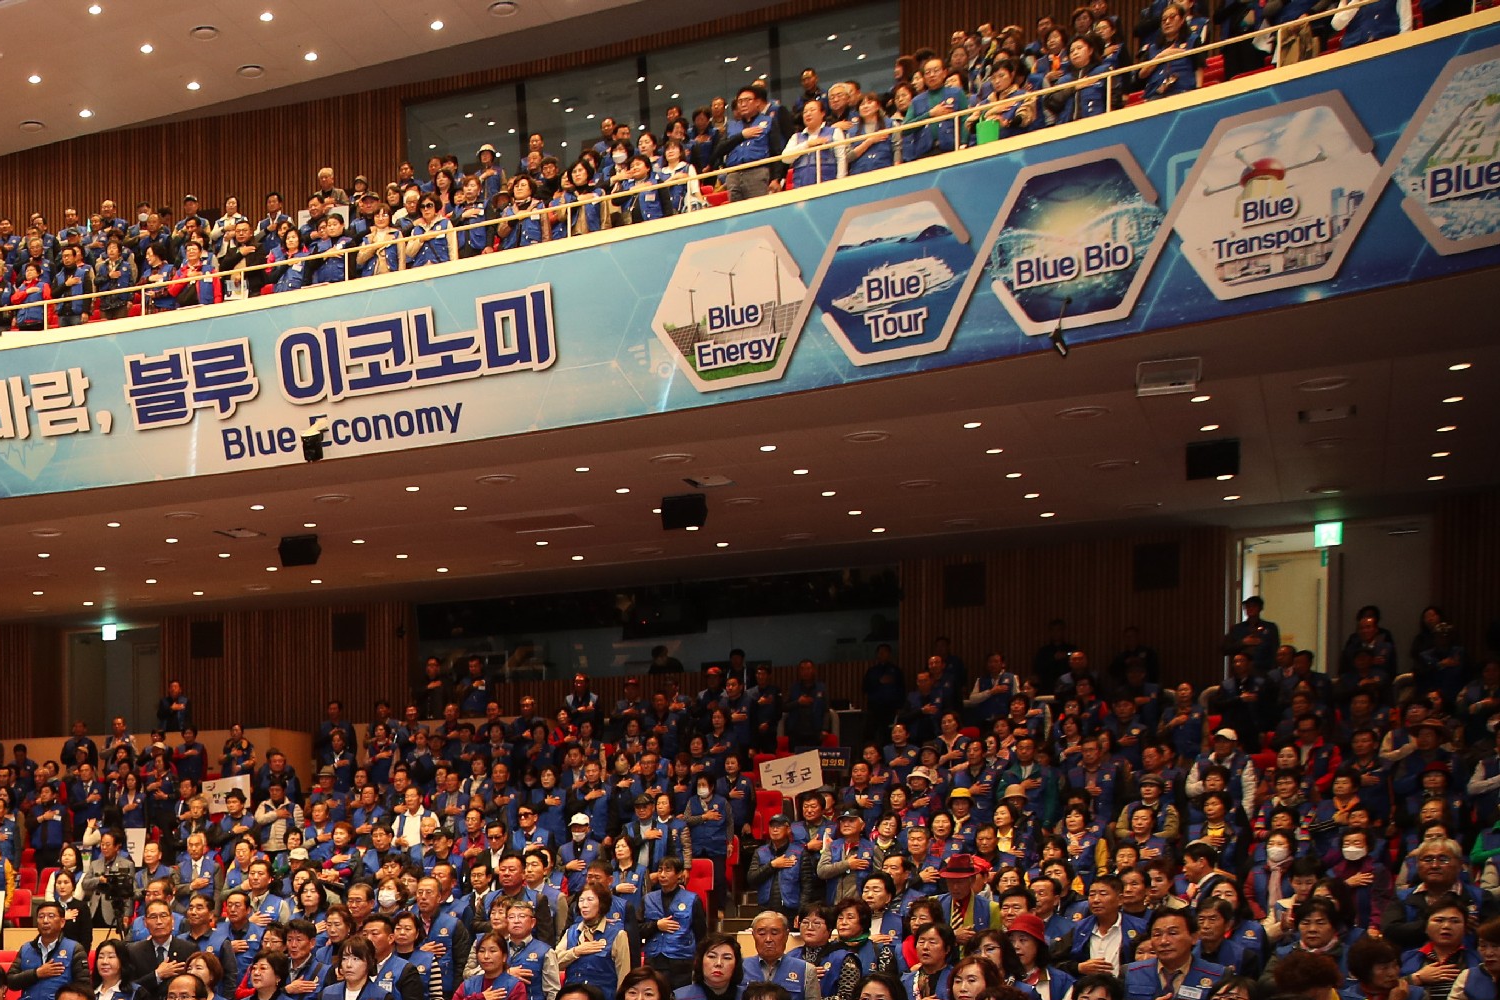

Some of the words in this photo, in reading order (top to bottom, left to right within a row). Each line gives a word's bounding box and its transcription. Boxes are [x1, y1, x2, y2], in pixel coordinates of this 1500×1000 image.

[1430, 161, 1500, 198] Blue
[1243, 197, 1294, 223] Blue
[1213, 219, 1326, 260] Transport
[1015, 254, 1077, 286] Blue
[1084, 242, 1129, 270] Bio
[866, 274, 921, 302] Blue
[709, 303, 760, 331] Blue
[868, 311, 925, 338] Tour
[126, 338, 258, 429] 블루
[278, 286, 555, 403] 이코노미
[697, 336, 778, 368] Energy
[222, 425, 296, 461] Blue
